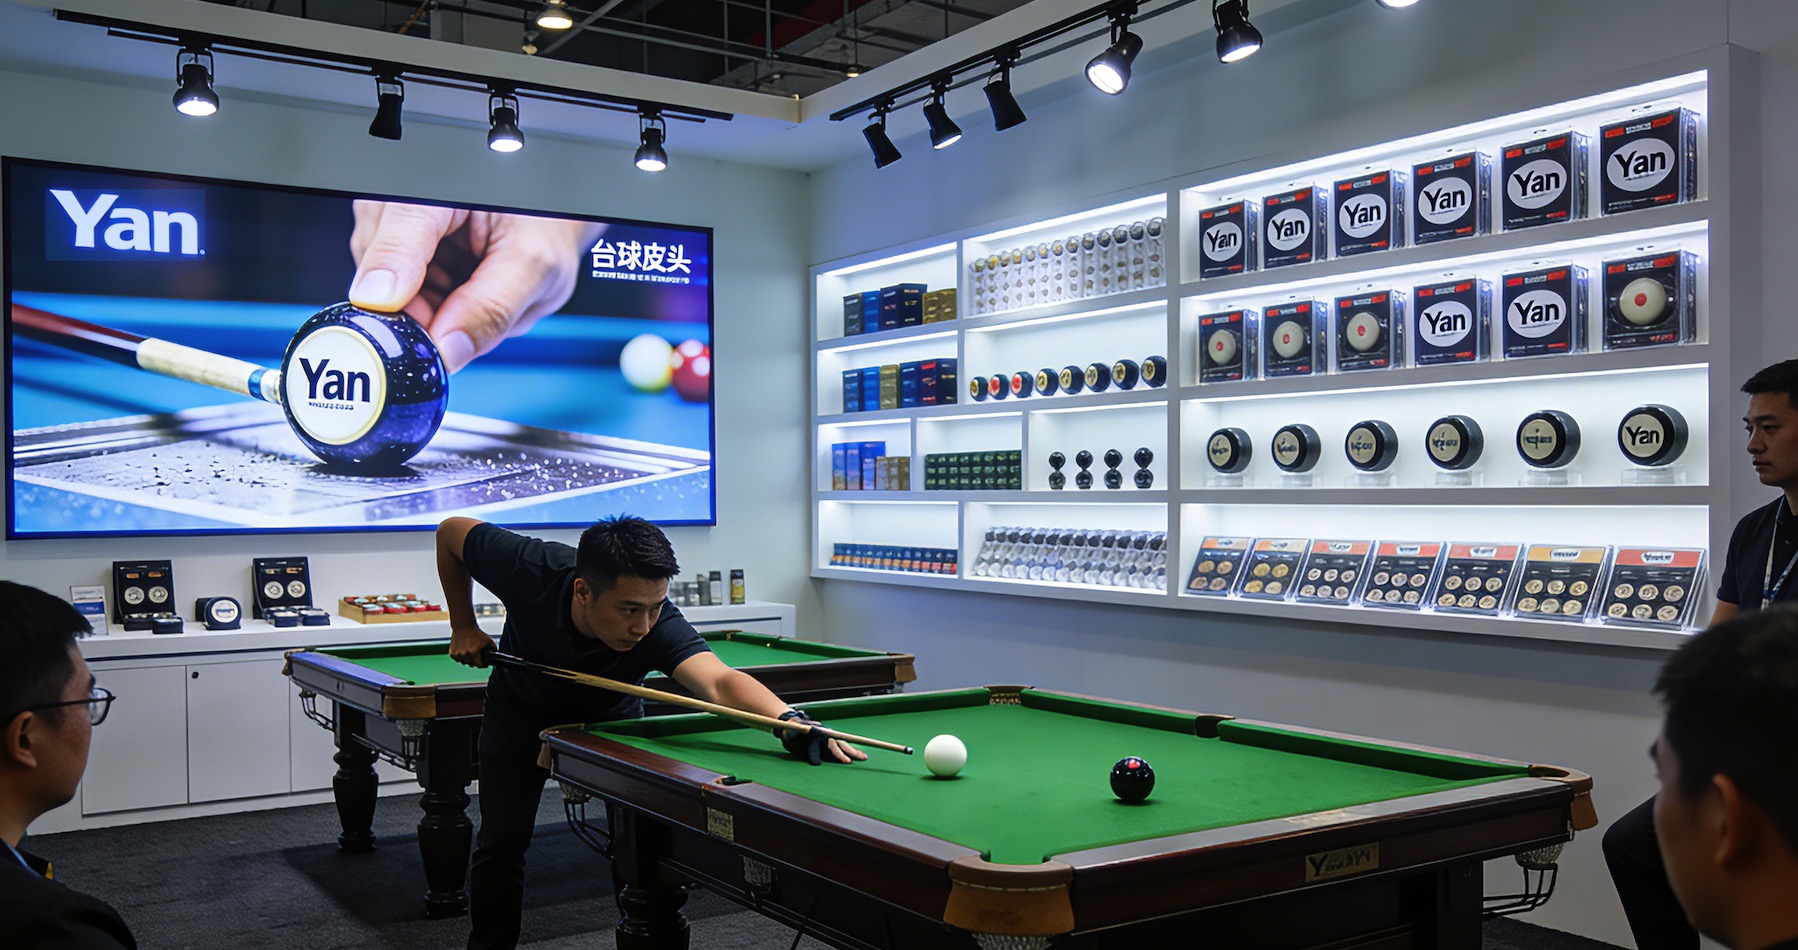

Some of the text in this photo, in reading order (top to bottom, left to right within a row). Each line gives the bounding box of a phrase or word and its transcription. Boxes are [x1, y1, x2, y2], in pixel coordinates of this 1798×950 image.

[1613, 150, 1666, 178] Yan
[1513, 170, 1560, 197] Yan
[1423, 187, 1466, 212] Yan
[1344, 203, 1381, 227] Yan
[1206, 229, 1237, 252] Yan
[1271, 218, 1305, 240] Yan
[591, 239, 692, 274] 台球皮头
[1423, 310, 1466, 335] Yan
[1514, 299, 1560, 325] Yan
[299, 358, 370, 403] Yan
[1625, 426, 1660, 446] Yan
